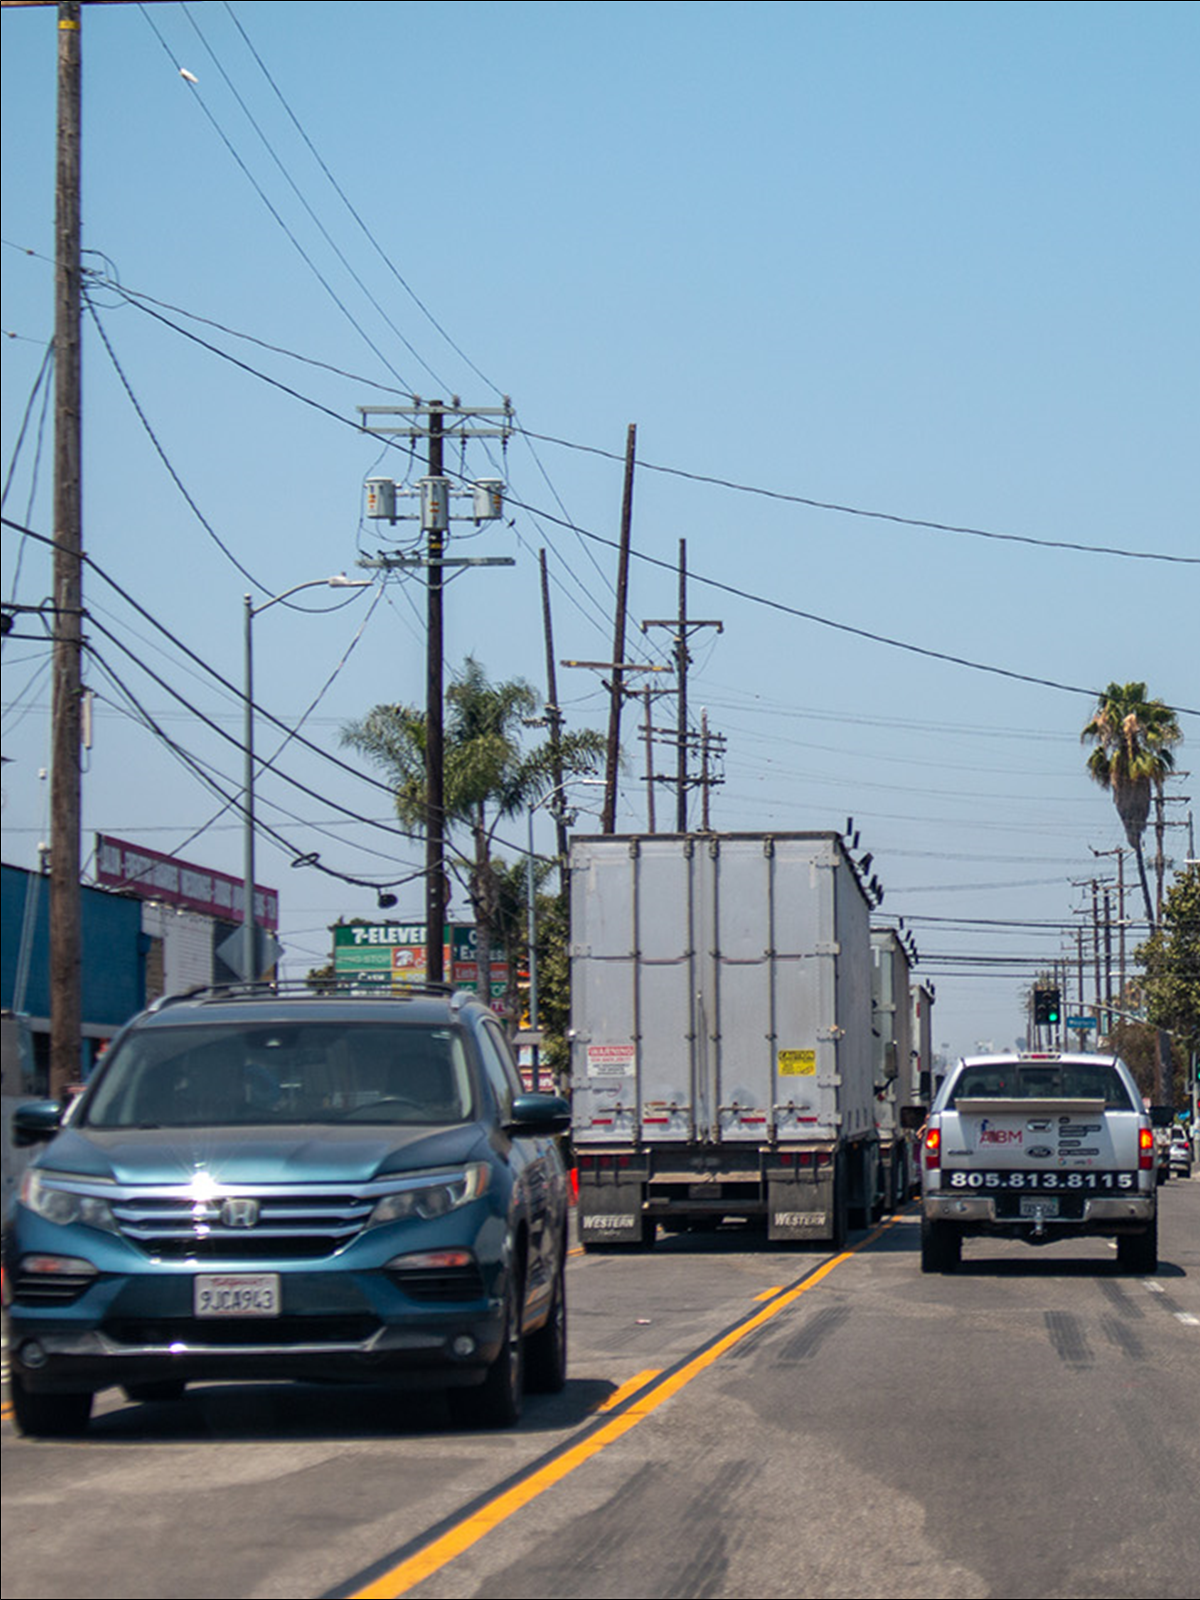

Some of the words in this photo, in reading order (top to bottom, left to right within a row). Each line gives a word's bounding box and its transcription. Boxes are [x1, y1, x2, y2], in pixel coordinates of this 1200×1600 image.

[951, 1172, 1133, 1187] 805.813.8115
[582, 1214, 635, 1229] WESTERN
[774, 1211, 827, 1226] WESTERN
